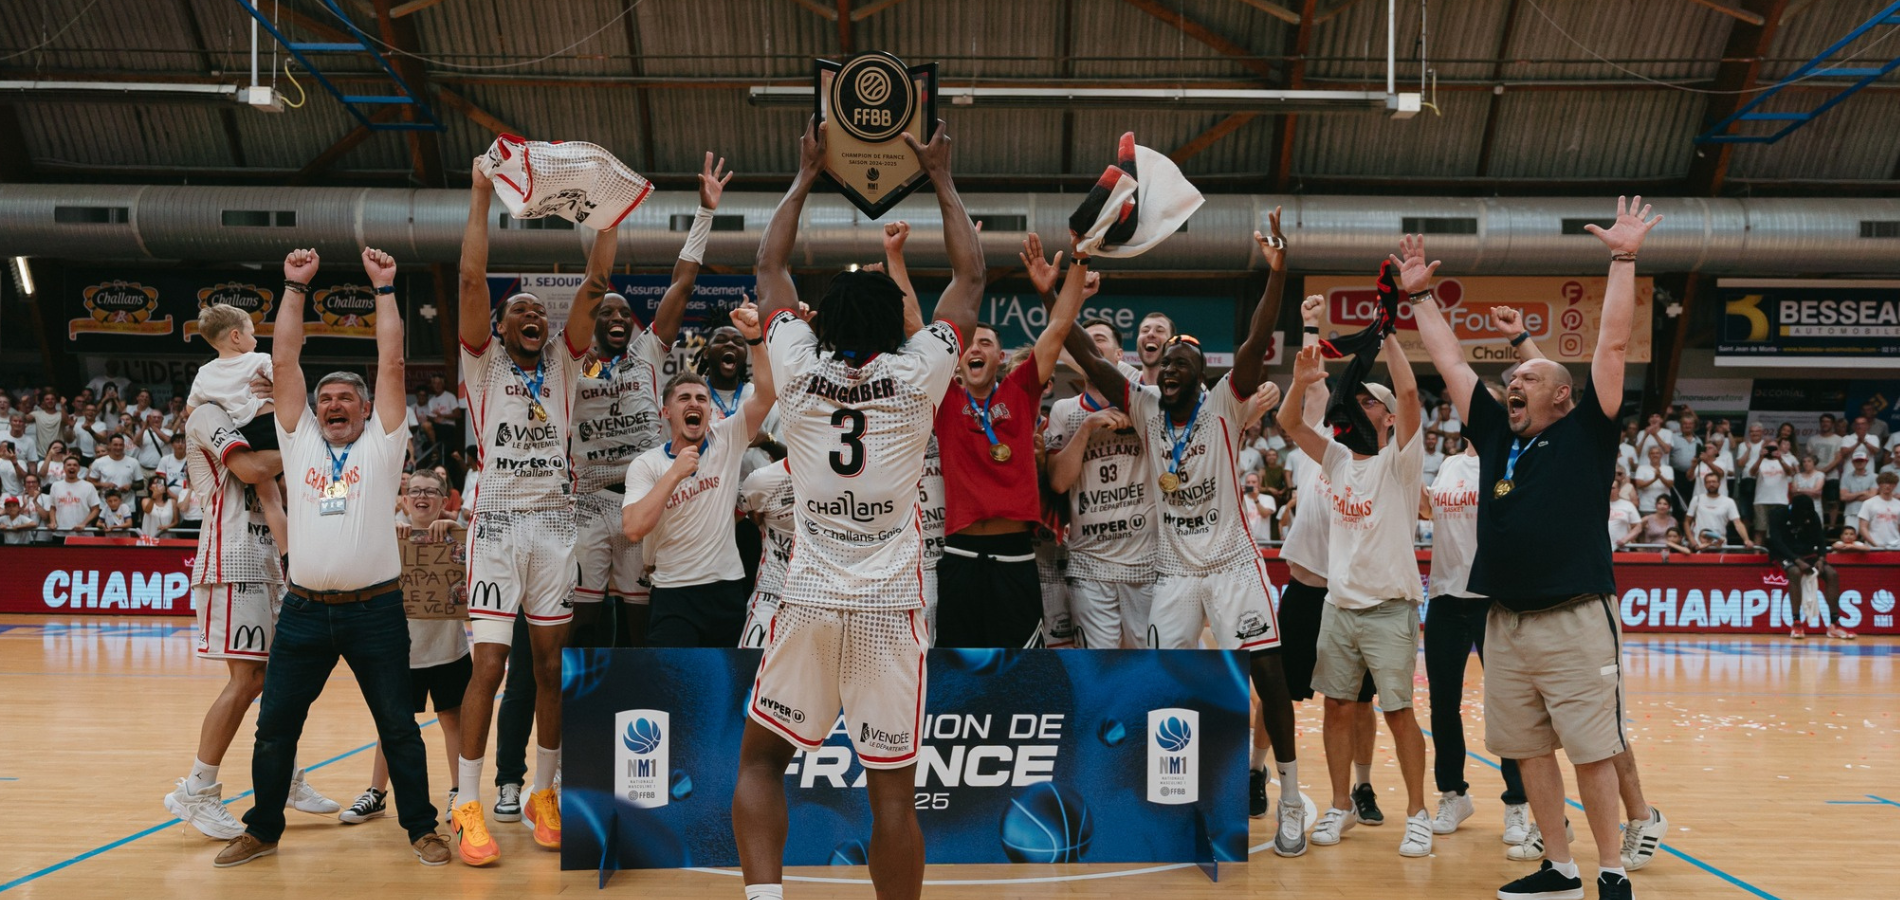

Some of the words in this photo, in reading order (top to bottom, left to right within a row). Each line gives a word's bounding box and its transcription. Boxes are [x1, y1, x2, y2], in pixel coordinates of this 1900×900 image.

[853, 108, 892, 127] FFBB
[522, 277, 532, 287] J.
[625, 284, 671, 295] Assuran
[692, 284, 746, 295] Placement
[96, 292, 144, 305] Challans
[326, 295, 375, 309] Challans
[1779, 300, 1900, 324] BESSEA
[1472, 346, 1522, 360] Challa
[806, 375, 895, 405] BENGABER
[828, 408, 868, 478] 3
[496, 457, 548, 470] HYPER
[514, 468, 554, 478] Challans
[1099, 464, 1118, 484] 93
[1089, 482, 1145, 506] VENDÉE
[1432, 491, 1479, 508] HALLAN
[321, 501, 344, 509] VIP
[1090, 505, 1099, 513] LE
[1099, 497, 1145, 513] DÉPARTEMENT
[1081, 519, 1128, 536] HYPER
[1097, 531, 1133, 543] Challans
[403, 544, 450, 567] LEZ
[402, 567, 441, 588] APA
[42, 569, 197, 610] CHAMP
[424, 603, 457, 616] VCB
[760, 696, 792, 718] HYPER
[1008, 713, 1065, 740] DE
[870, 728, 910, 745] VENDÉE
[876, 742, 910, 752] DÉPARTEMENT
[627, 758, 657, 778] NM1
[784, 745, 1059, 789] RNCE
[1159, 756, 1187, 775] NM1
[639, 791, 656, 799] FFBB
[914, 792, 950, 810] 25
